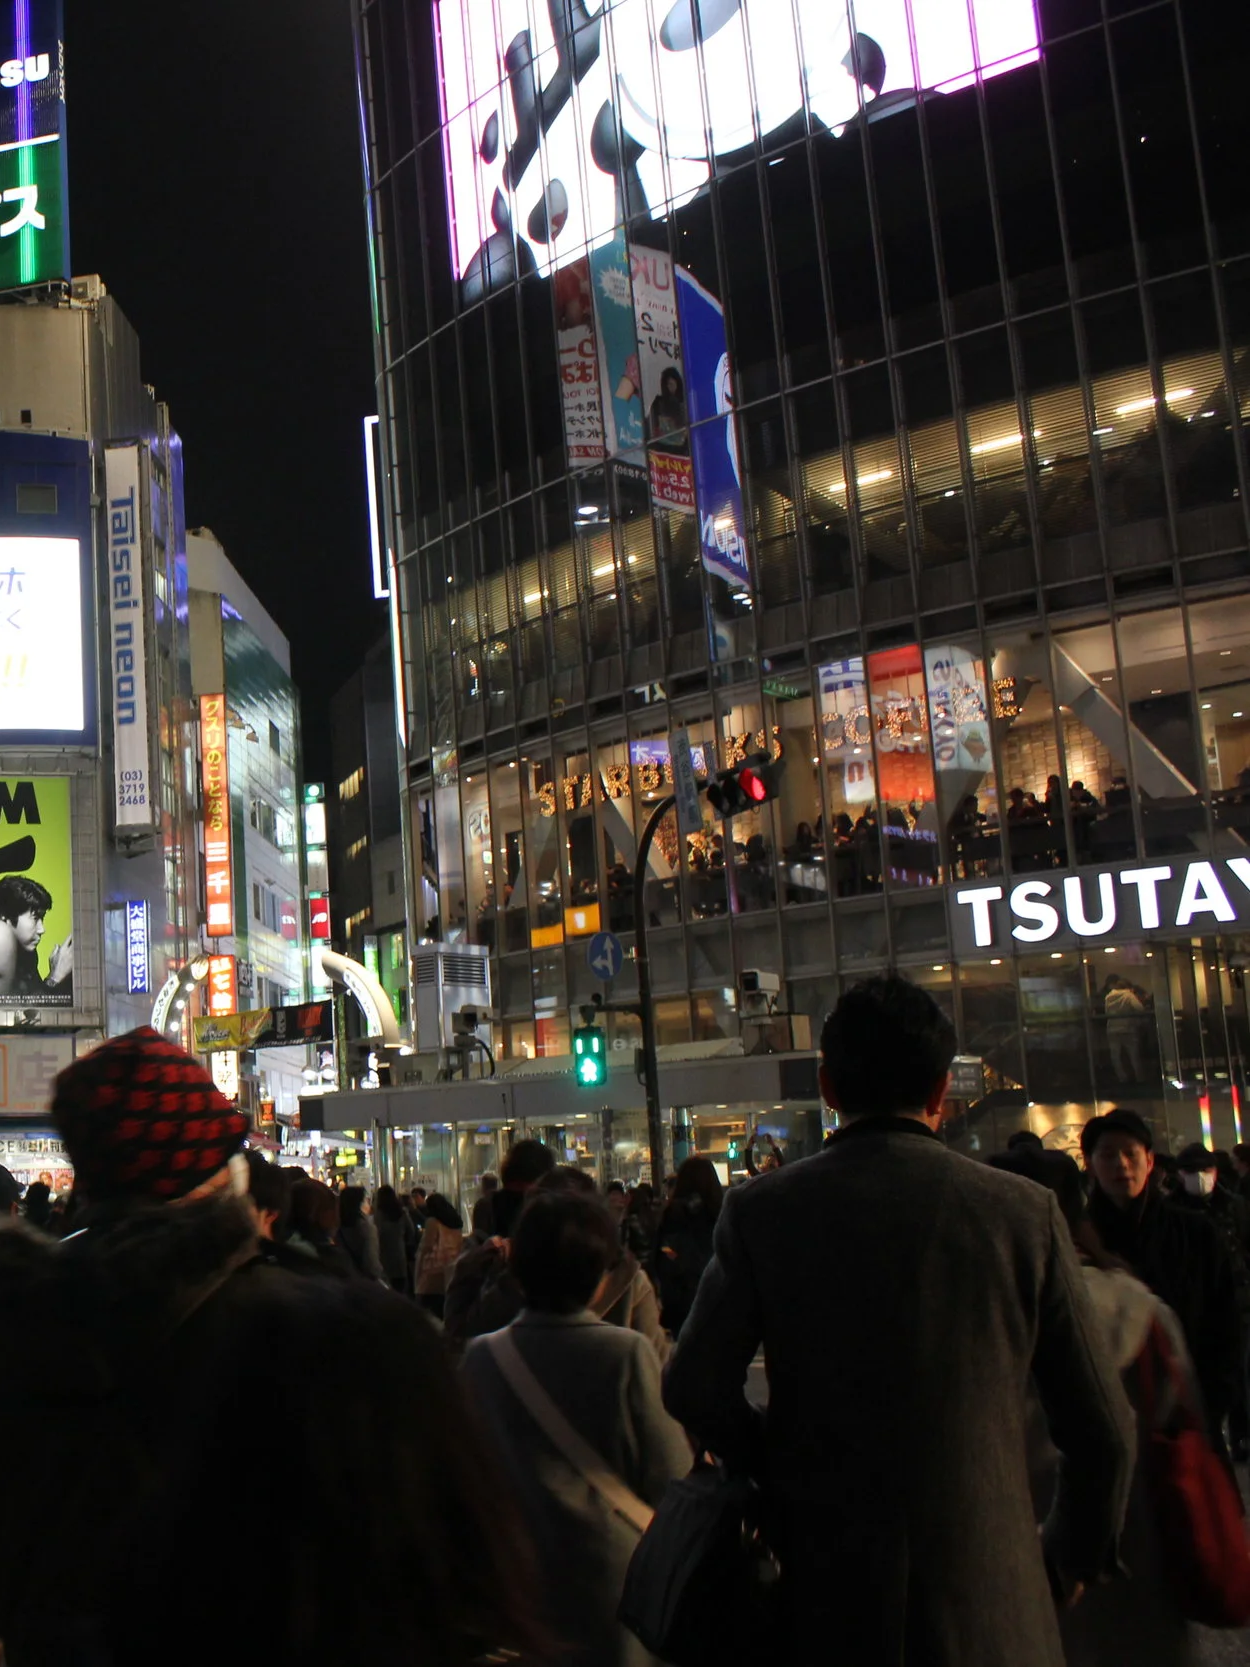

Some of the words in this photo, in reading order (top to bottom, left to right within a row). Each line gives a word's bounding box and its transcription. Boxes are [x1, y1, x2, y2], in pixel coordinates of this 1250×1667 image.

[110, 485, 139, 611] Taisei
[115, 621, 137, 725] neon
[118, 782, 145, 795] 3719
[120, 770, 143, 782] (03)
[205, 700, 225, 832] クスリのことなら
[118, 794, 146, 806] 2468
